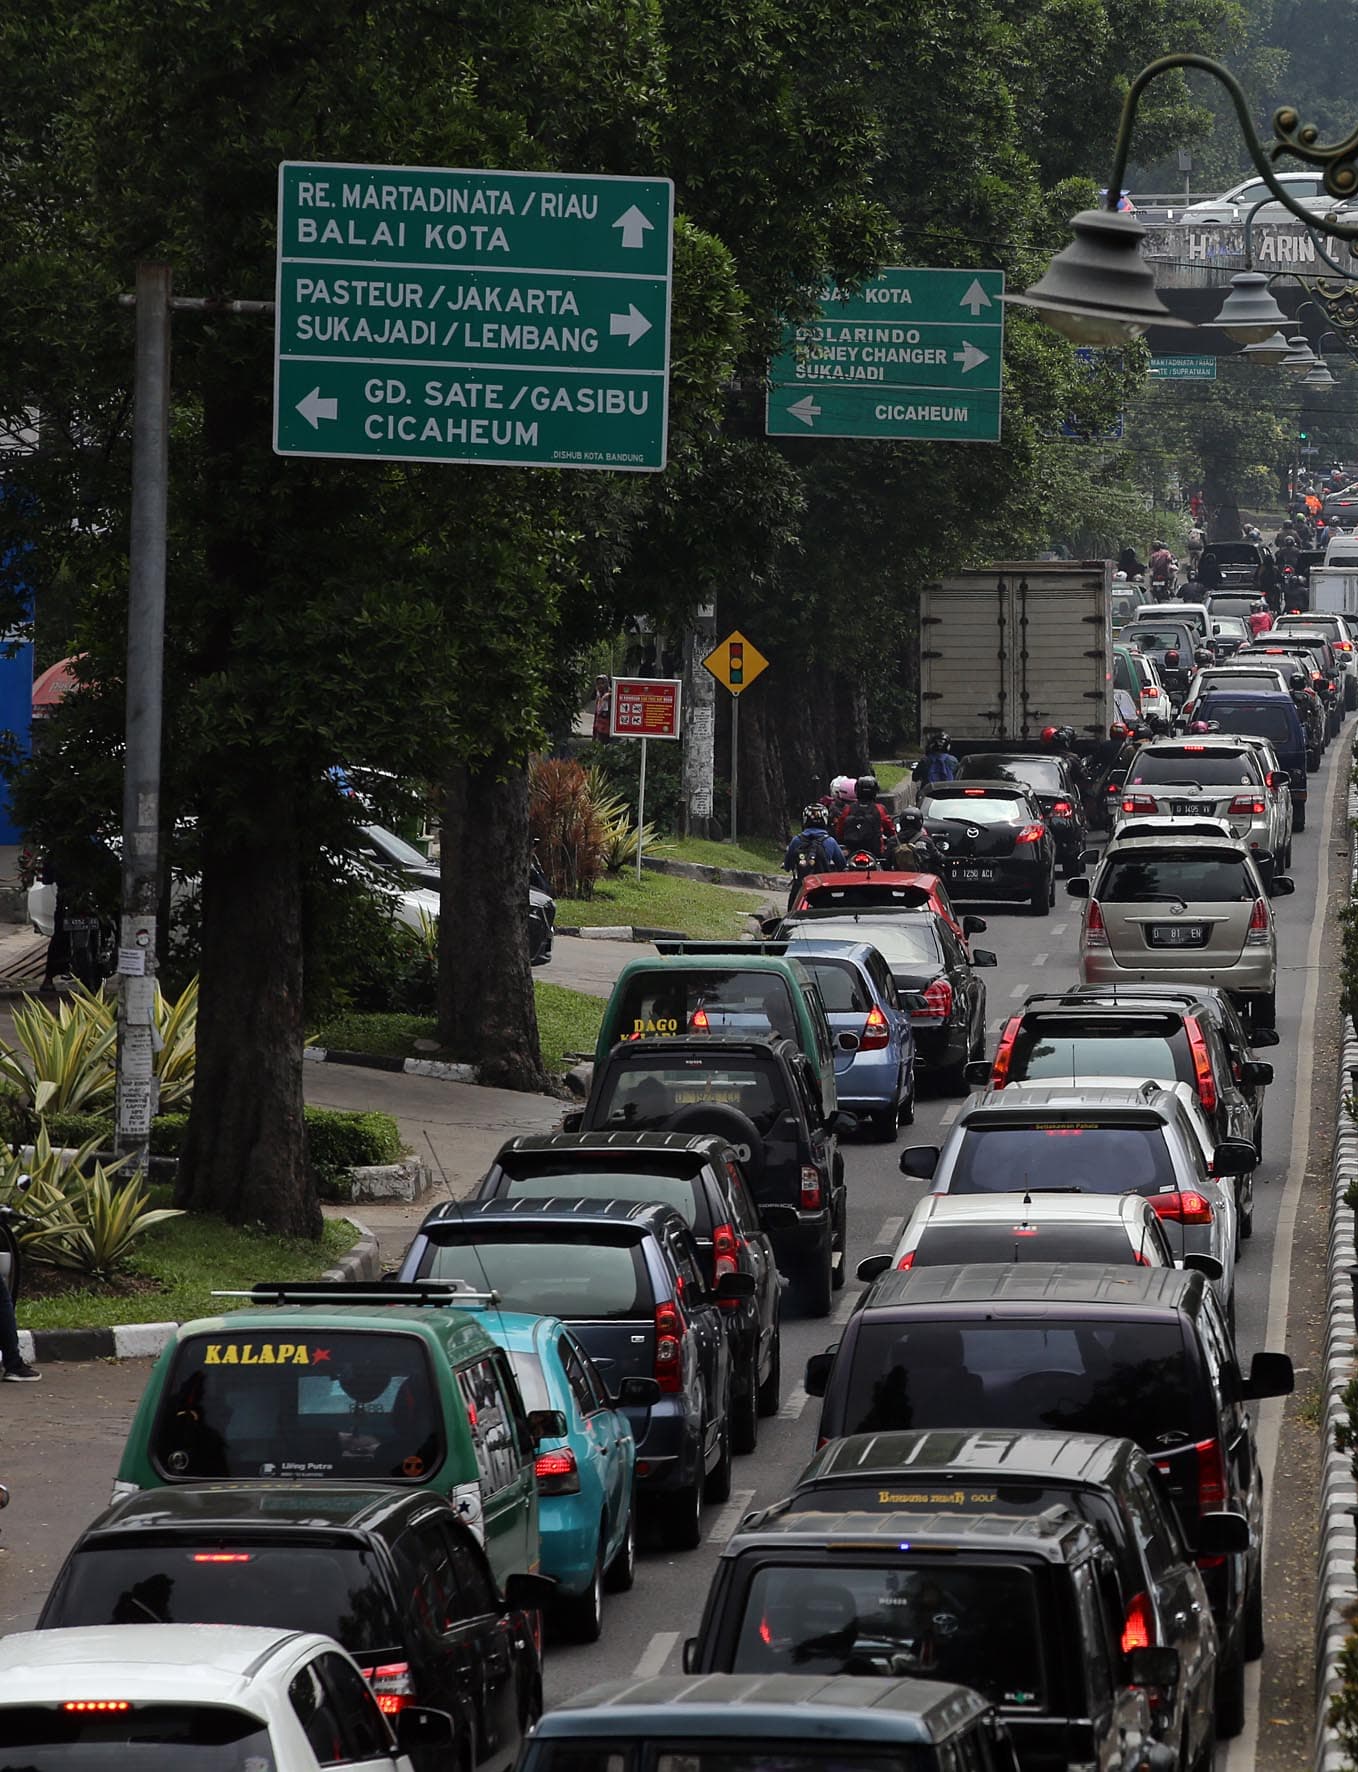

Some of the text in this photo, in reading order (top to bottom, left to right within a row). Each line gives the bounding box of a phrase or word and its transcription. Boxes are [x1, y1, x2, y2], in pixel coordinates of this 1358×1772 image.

[297, 182, 336, 208] RE.
[342, 184, 515, 216] MARTADINATA
[541, 195, 599, 219] RIAU
[297, 218, 511, 252] BALAI KOTA
[296, 278, 424, 309] PASTEUR
[447, 287, 580, 316] JAKARTA
[865, 288, 912, 304] KOTA
[296, 315, 436, 346] SUKAJADI
[464, 323, 599, 353] LEMBANG
[862, 347, 947, 365] CHANGER
[796, 364, 884, 381] SUKAJADI
[364, 378, 412, 406] GD.
[425, 381, 504, 410] SATE
[530, 386, 649, 416] GASIBU
[875, 404, 968, 422] CICAHEUM
[364, 414, 539, 447] CICAHEUM
[553, 450, 645, 463] DISHUB KOTA BANDUNG
[634, 1018, 677, 1033] DAGO
[204, 1344, 310, 1365] KALAPA
[971, 1494, 998, 1503] GOLF
